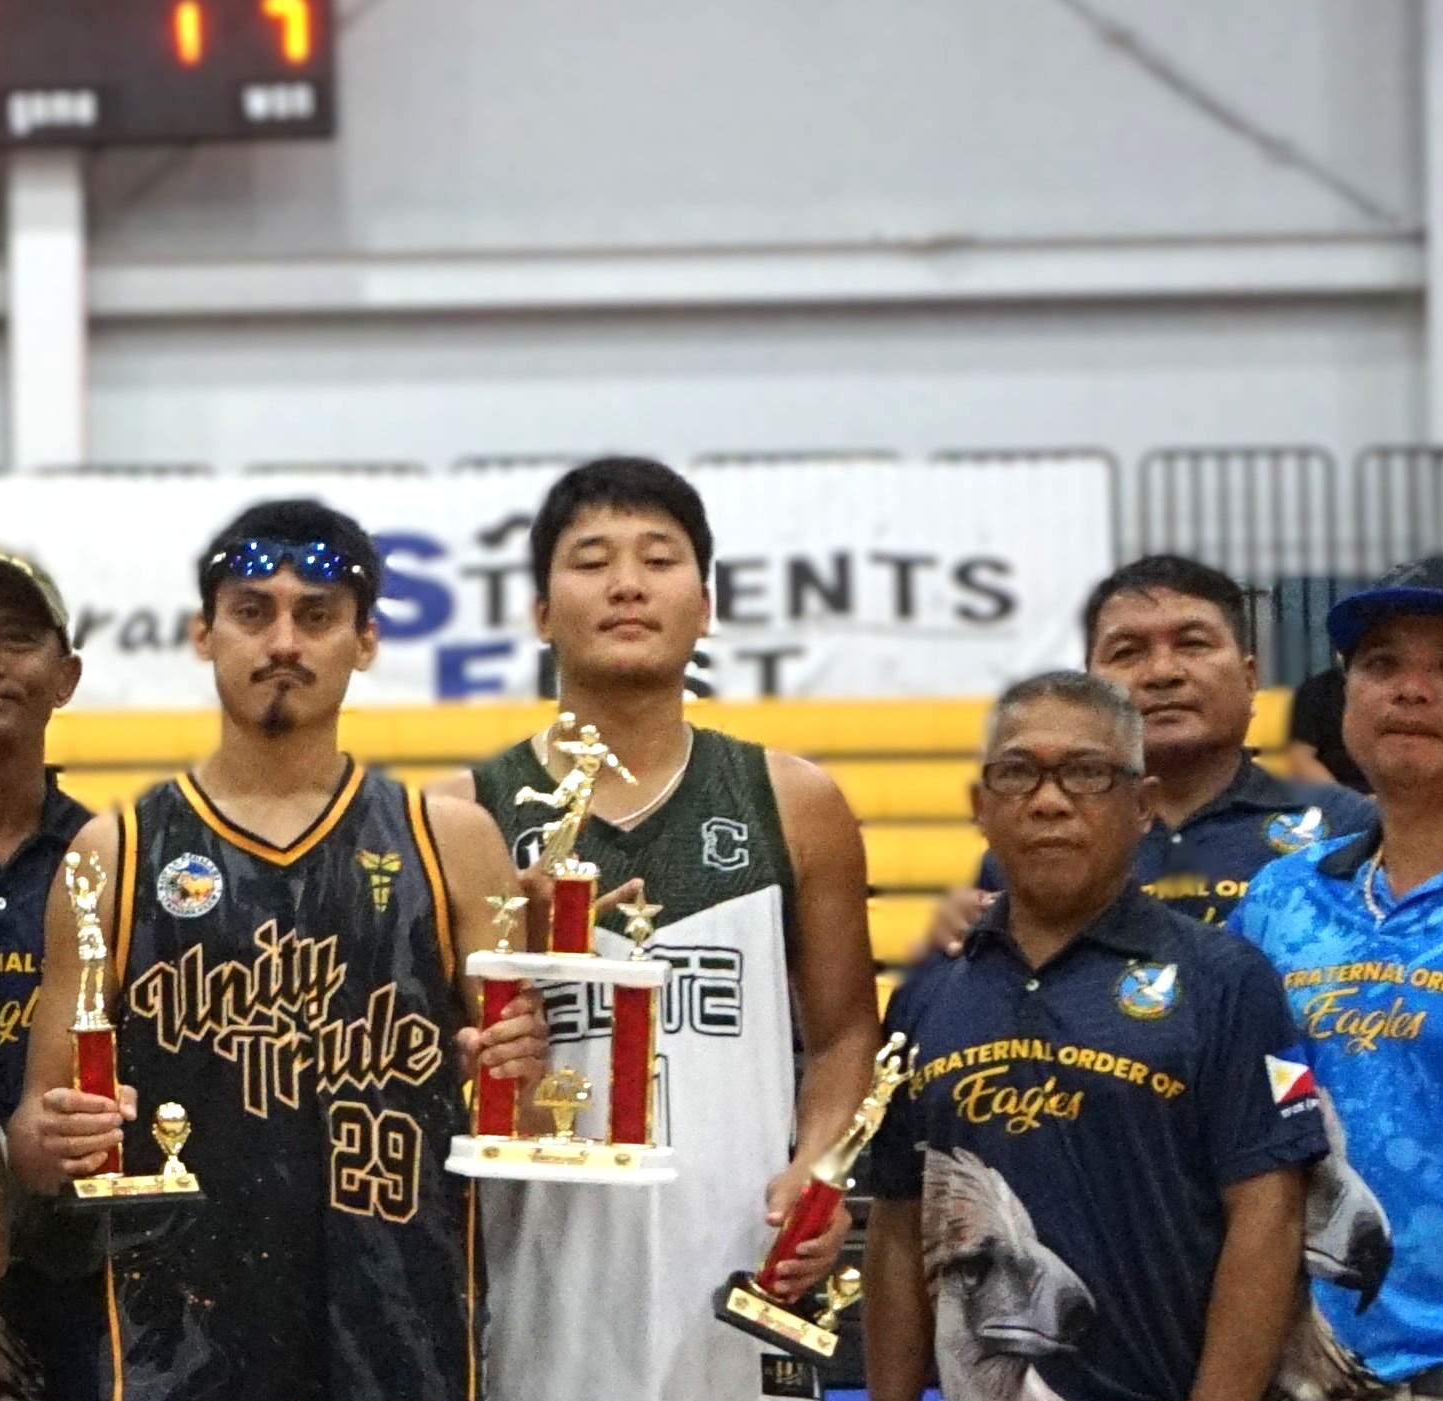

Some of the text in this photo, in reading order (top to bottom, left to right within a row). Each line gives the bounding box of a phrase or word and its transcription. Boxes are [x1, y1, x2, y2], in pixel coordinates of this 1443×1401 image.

[373, 529, 1017, 643] STENTS
[702, 816, 750, 871] C
[130, 918, 348, 1053] Unity
[544, 944, 743, 1043] ELTE
[1303, 986, 1428, 1054] Eagles
[923, 1038, 1186, 1099] FRATERNAL ORDER OF
[328, 1100, 422, 1223] 29
